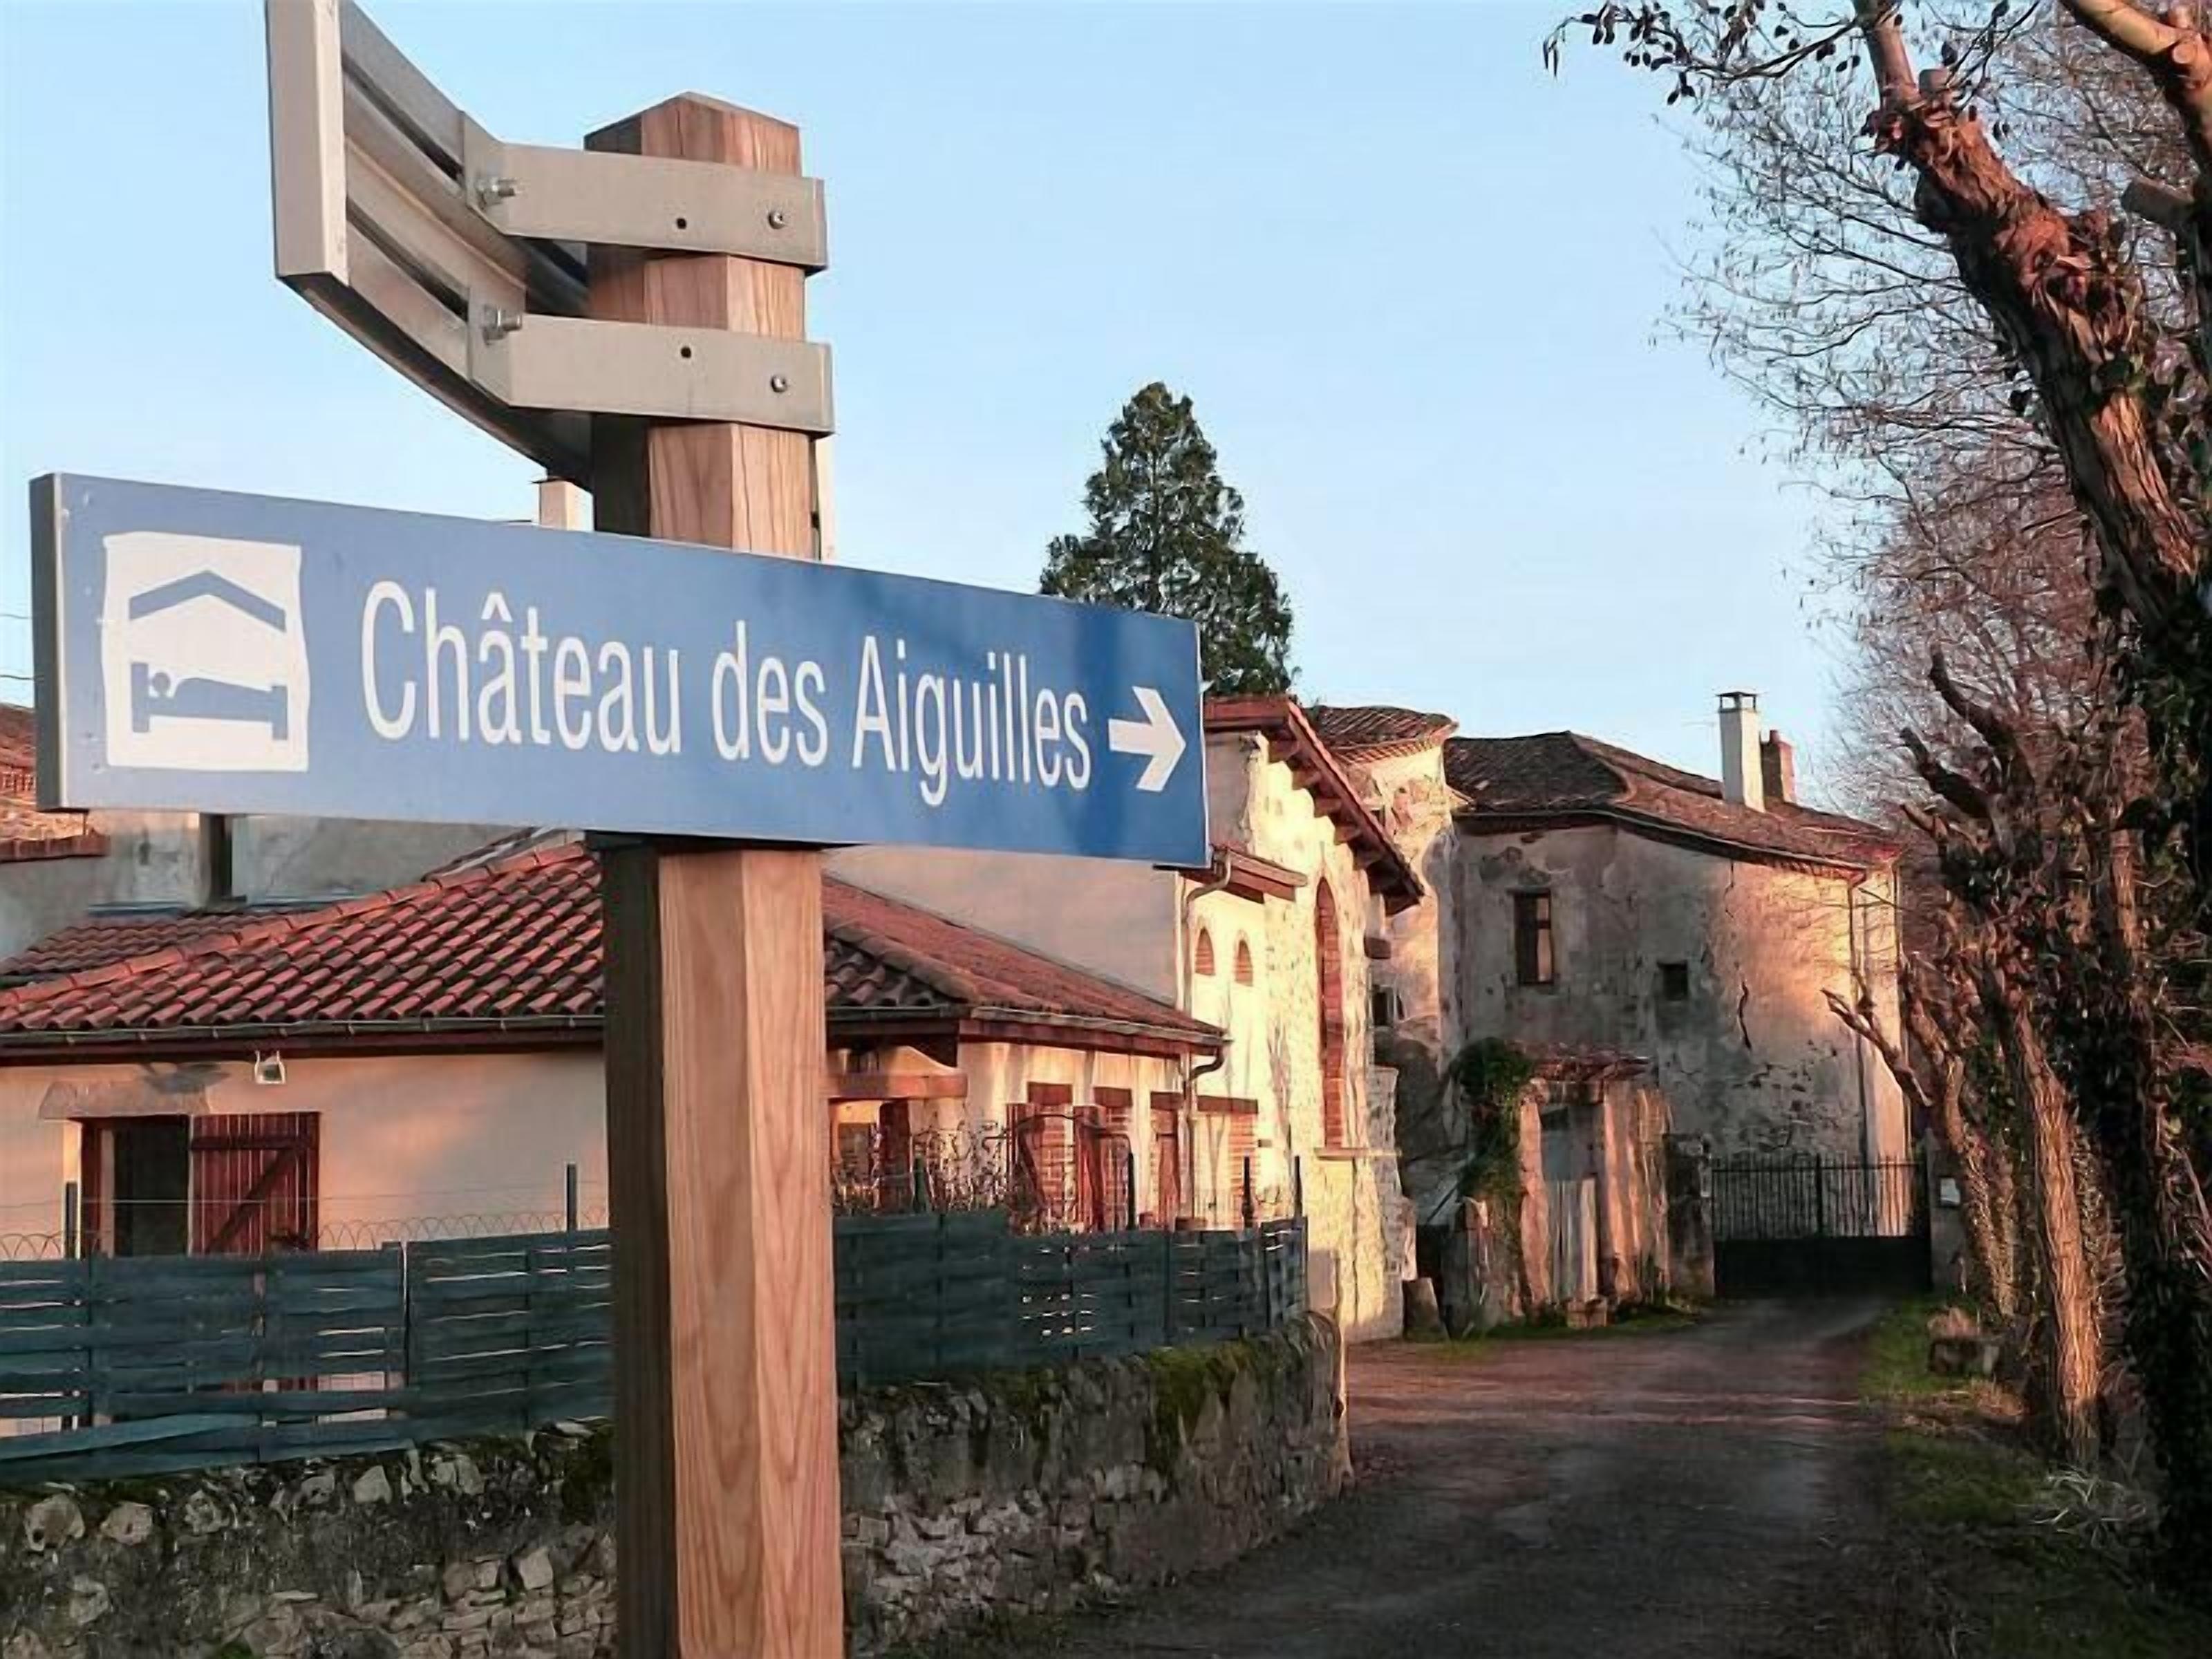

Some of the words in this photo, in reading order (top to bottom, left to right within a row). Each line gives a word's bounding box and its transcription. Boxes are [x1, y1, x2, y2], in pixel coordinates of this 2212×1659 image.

[361, 579, 682, 756] Château
[711, 619, 828, 767] des
[852, 635, 1091, 807] Aiguilles
